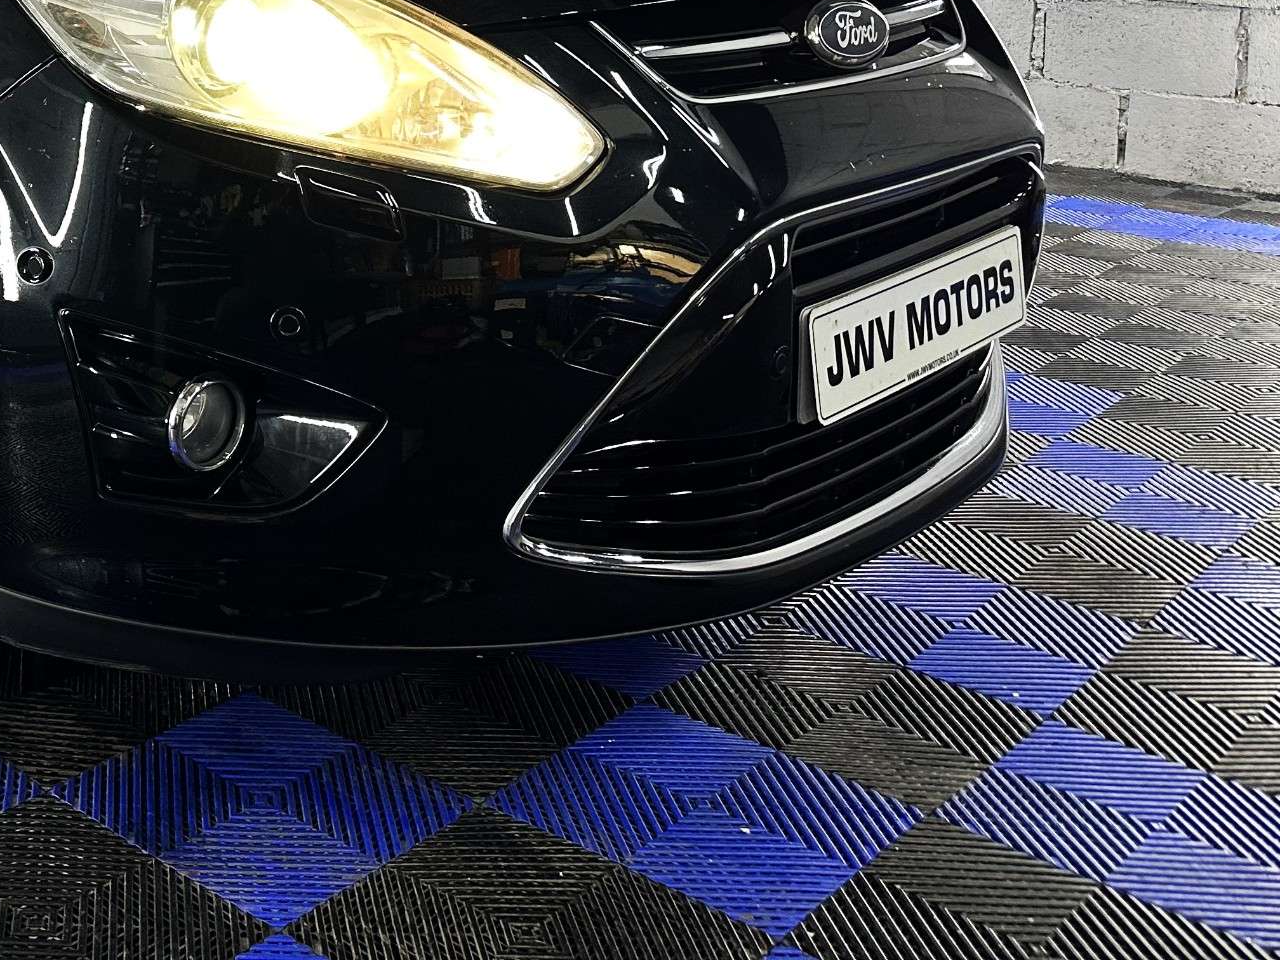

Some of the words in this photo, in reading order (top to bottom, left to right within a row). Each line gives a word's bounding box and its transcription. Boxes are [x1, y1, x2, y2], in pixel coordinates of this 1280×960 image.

[836, 9, 878, 48] Ford
[826, 311, 895, 387] JWV
[905, 259, 1014, 351] MOTORS
